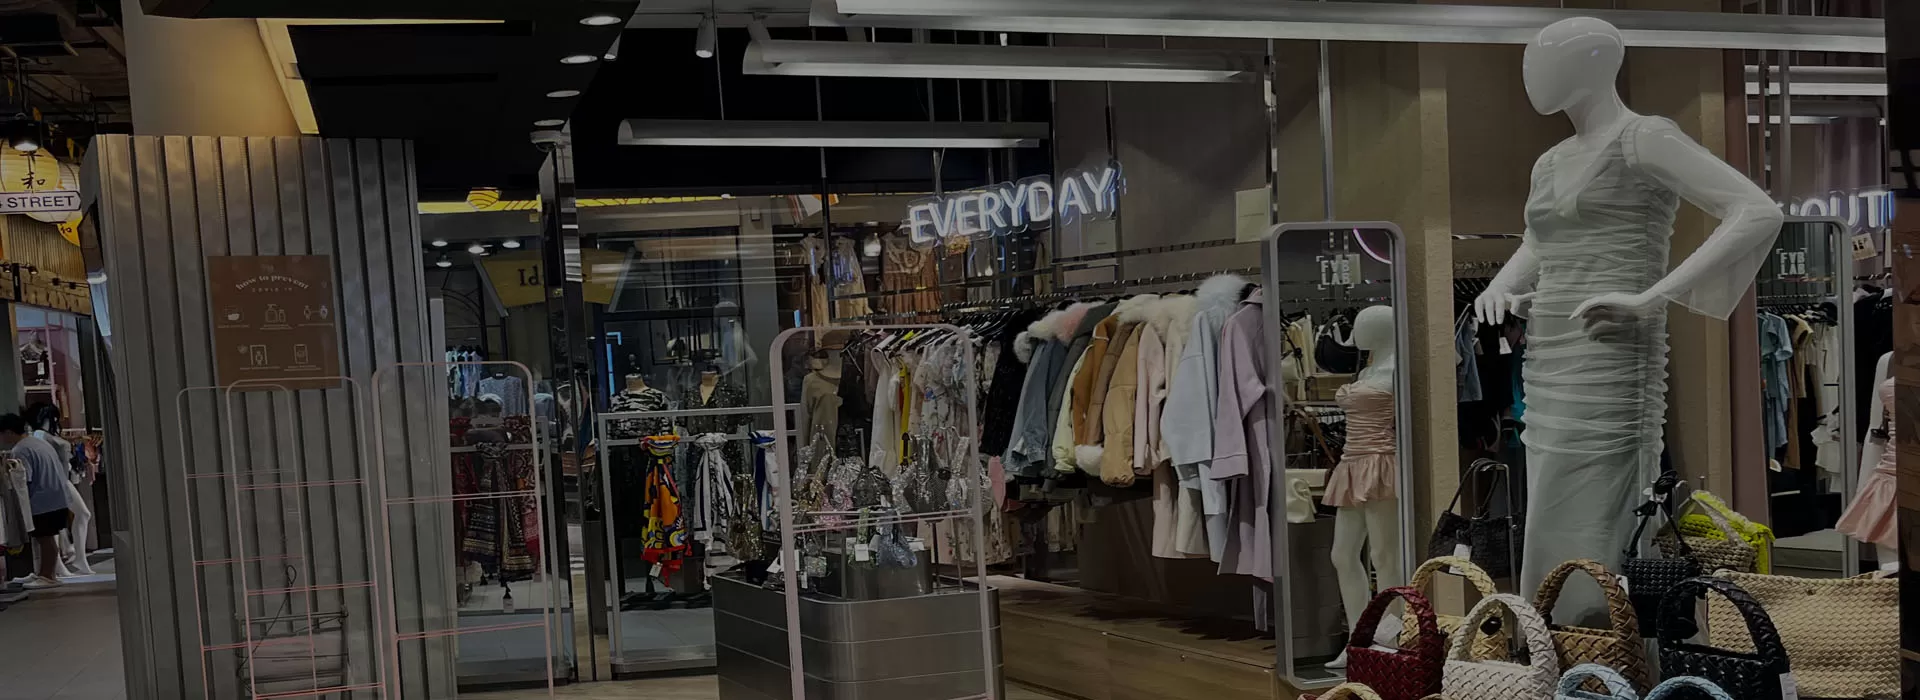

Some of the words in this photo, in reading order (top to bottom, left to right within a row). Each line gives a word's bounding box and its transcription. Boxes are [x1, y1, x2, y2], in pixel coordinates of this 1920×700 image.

[7, 195, 75, 209] STREET
[910, 167, 1117, 243] EVERYDAY
[1780, 263, 1806, 275] LAB
[235, 277, 256, 290] how
[271, 275, 310, 290] prevent
[1321, 272, 1350, 285] LAB
